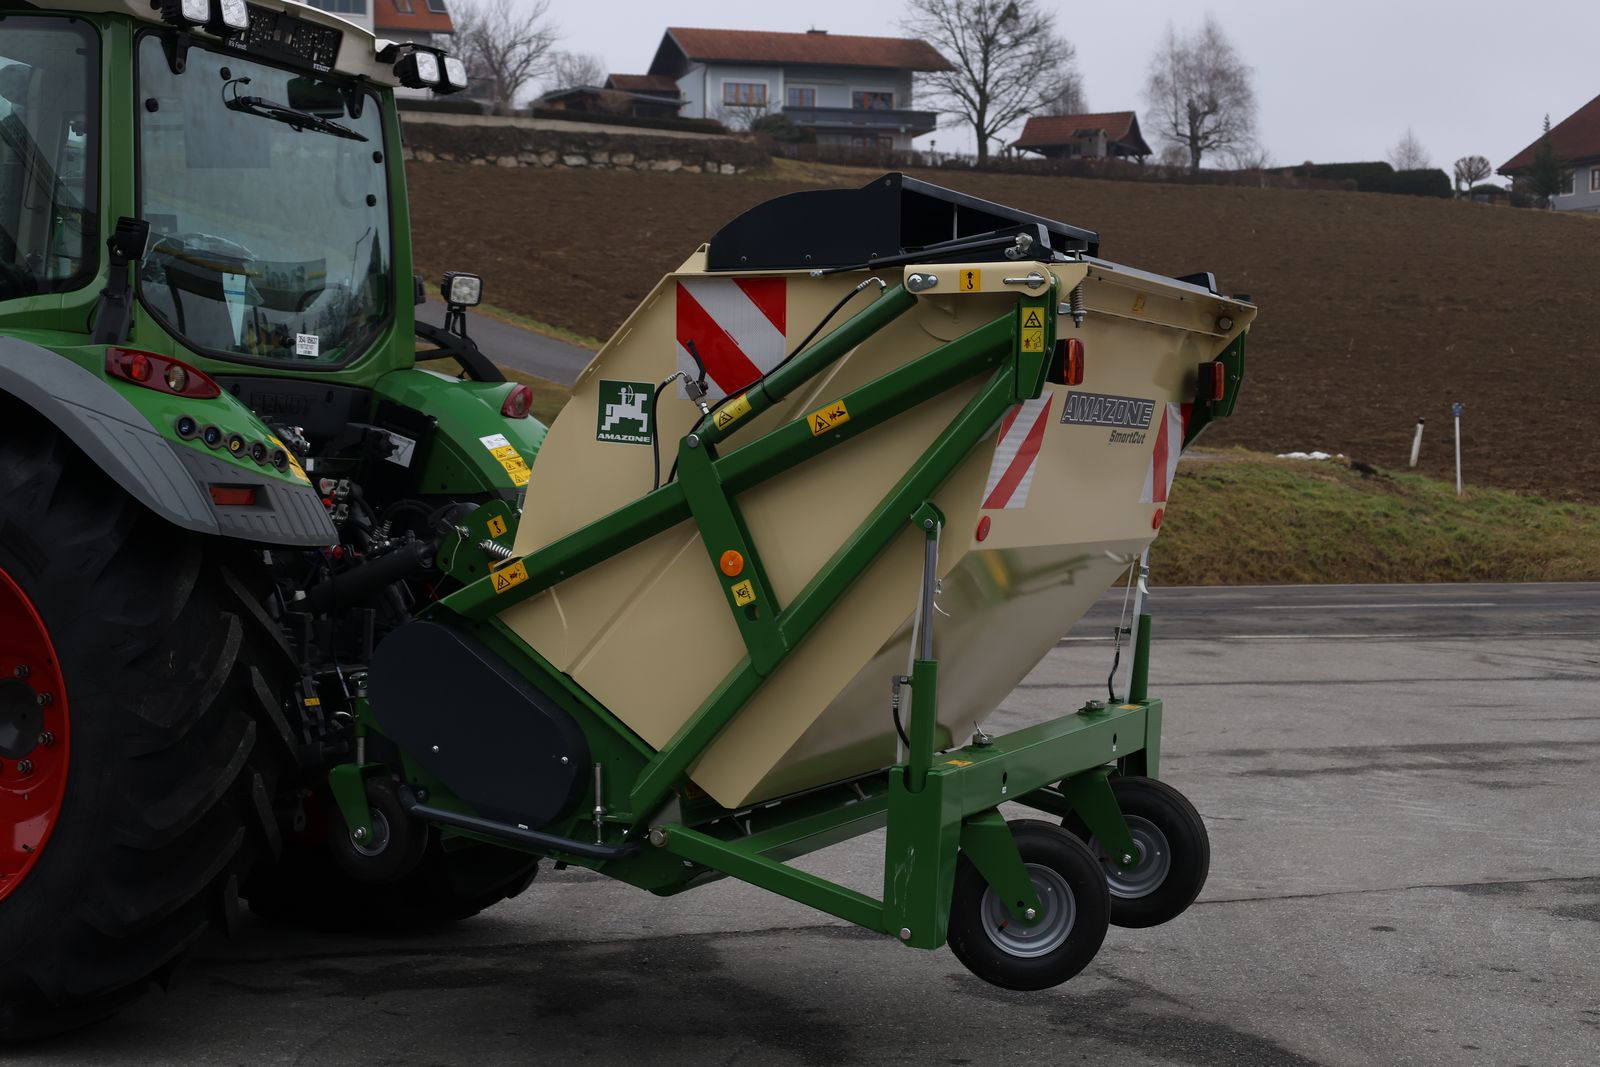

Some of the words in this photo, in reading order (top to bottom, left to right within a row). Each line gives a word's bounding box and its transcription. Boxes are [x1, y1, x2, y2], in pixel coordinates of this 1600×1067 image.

[1062, 394, 1154, 427] AMAZONE
[597, 433, 651, 443] AMAZONE
[1109, 429, 1146, 445] SmartCut
